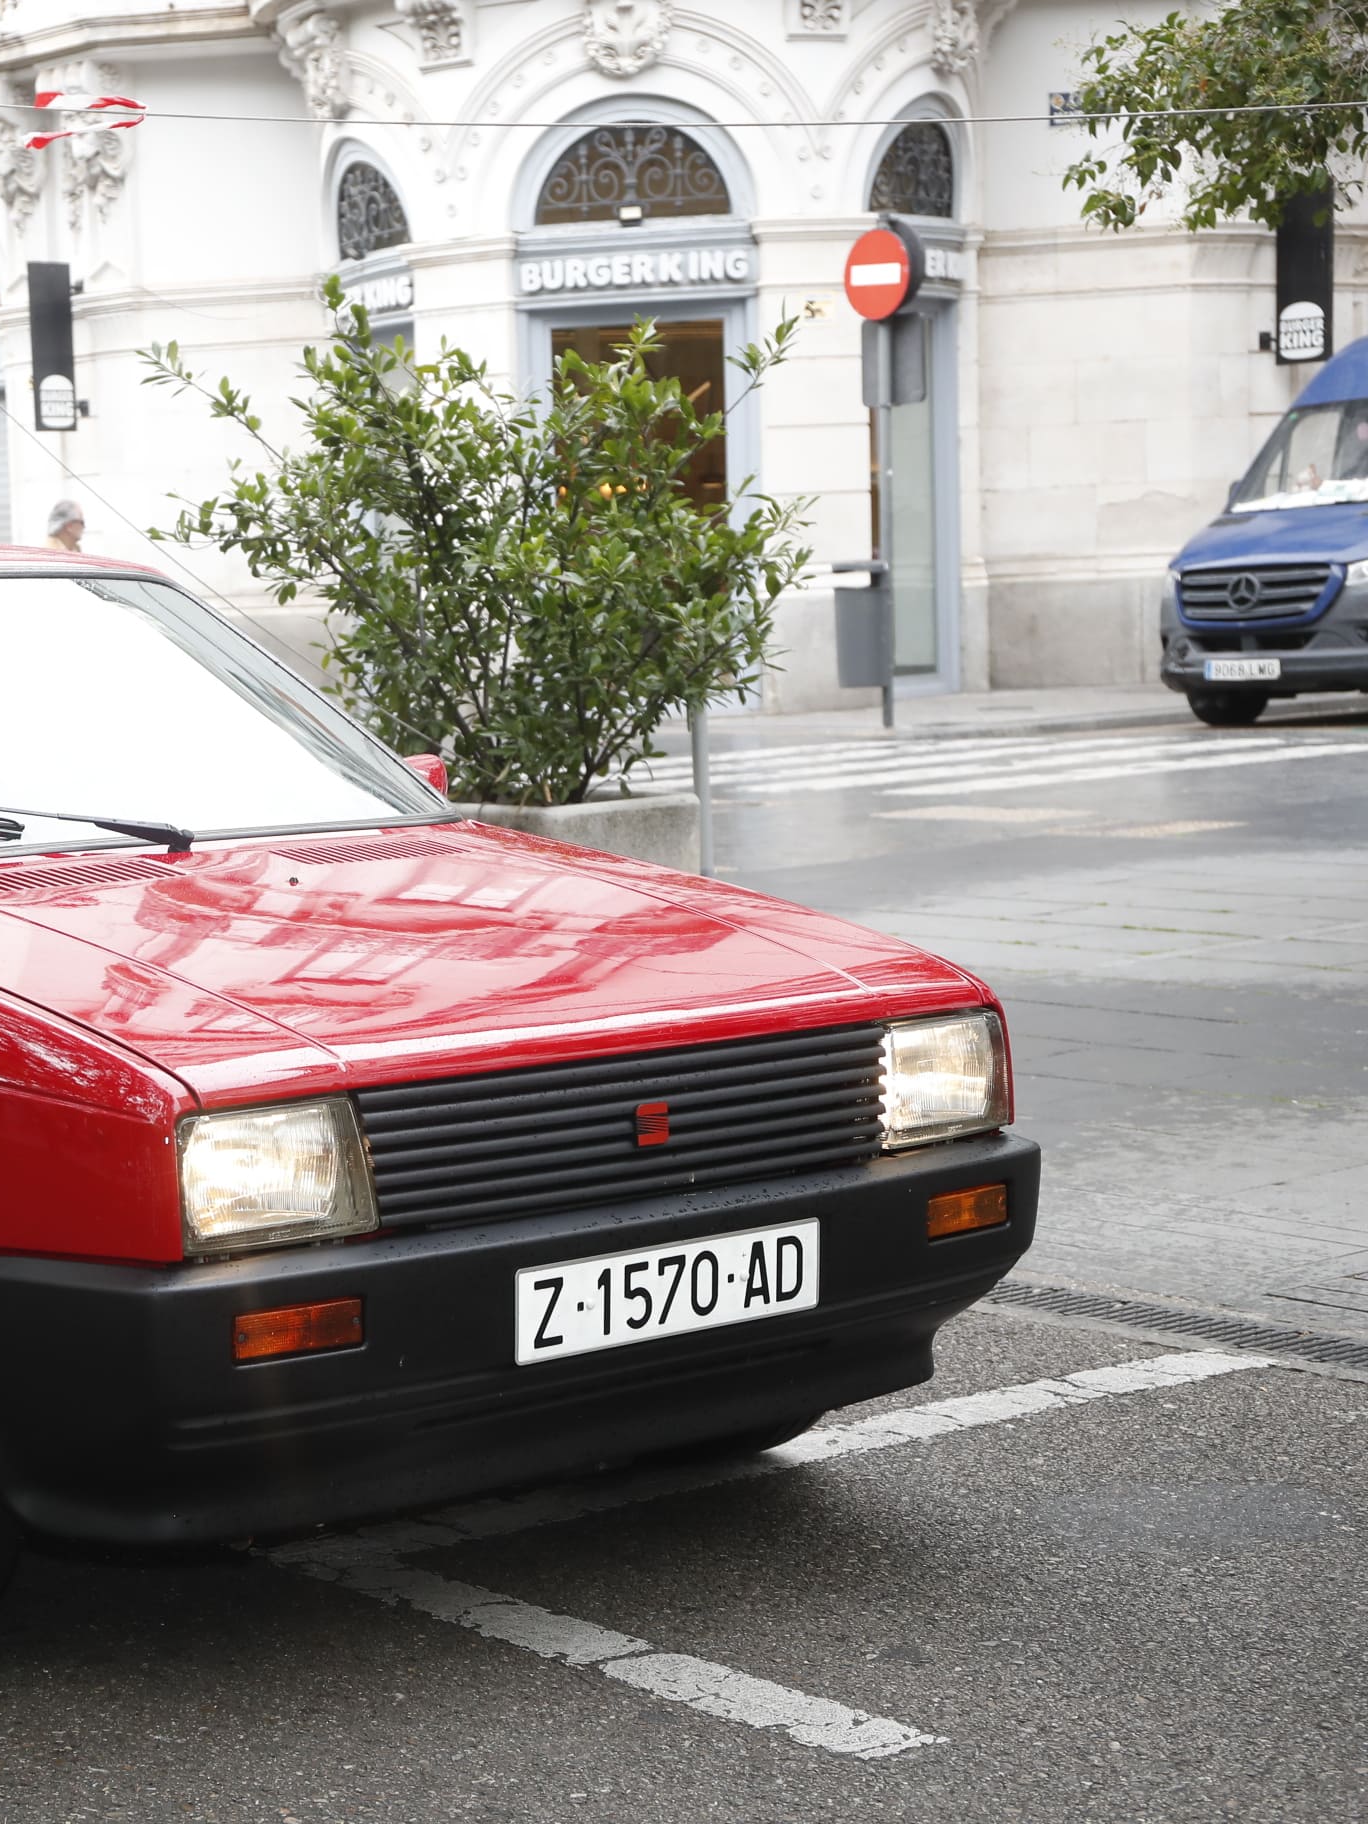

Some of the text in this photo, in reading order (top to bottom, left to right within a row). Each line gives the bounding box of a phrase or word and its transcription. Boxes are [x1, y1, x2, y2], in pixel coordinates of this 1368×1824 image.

[519, 249, 750, 293] BURGER KING
[363, 275, 412, 309] KING
[1279, 329, 1325, 349] KING
